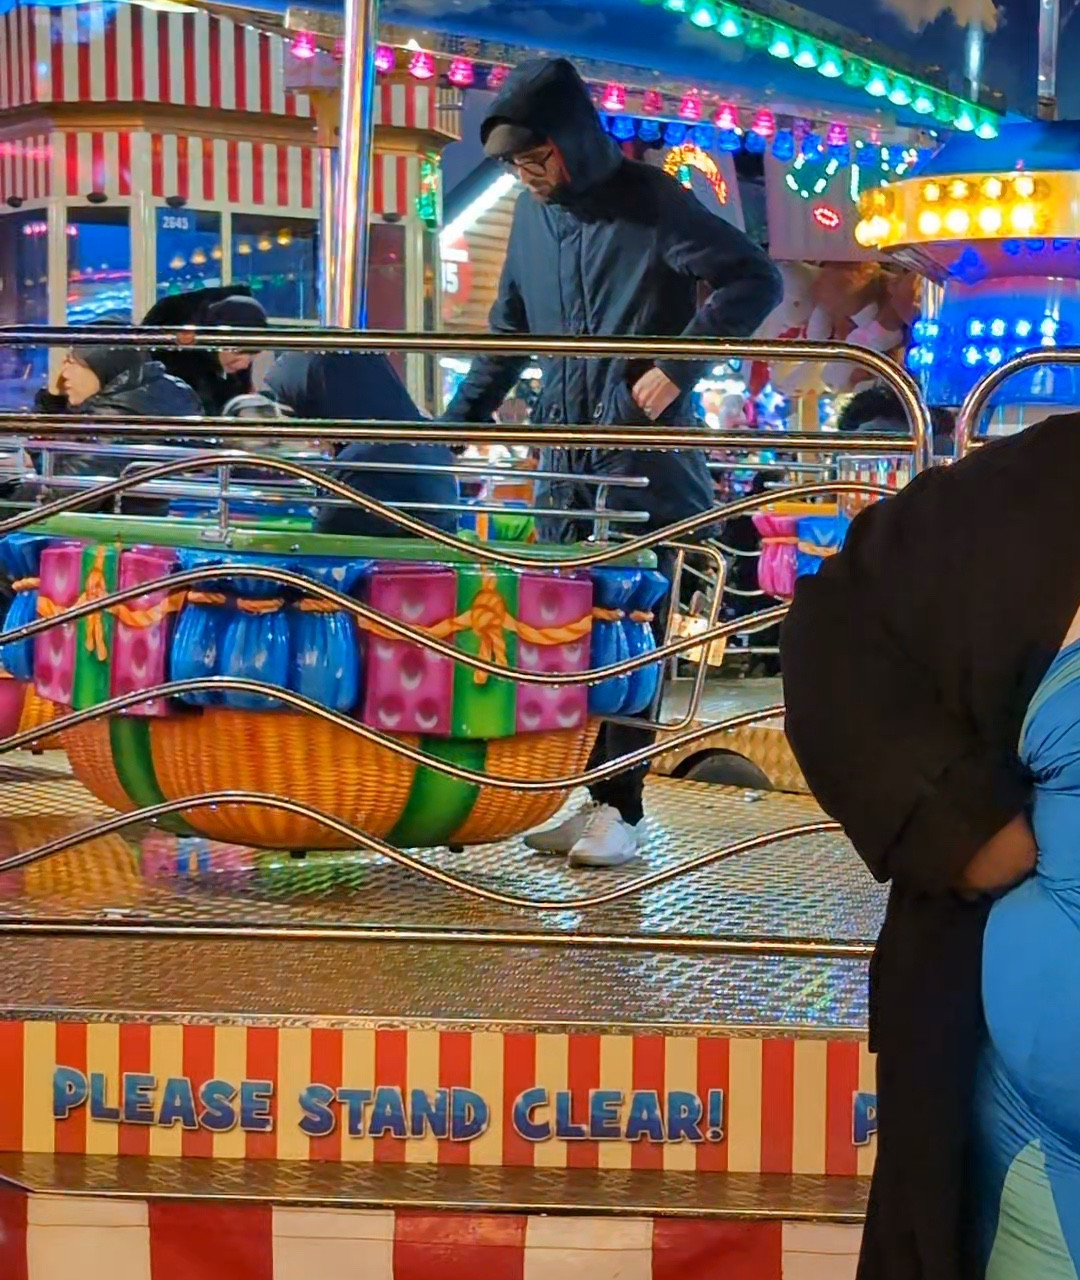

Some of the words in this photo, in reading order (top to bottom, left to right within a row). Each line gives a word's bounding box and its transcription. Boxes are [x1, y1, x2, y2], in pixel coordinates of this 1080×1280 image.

[53, 1065, 273, 1132] PLEASE
[299, 1083, 489, 1142] STAND
[512, 1086, 725, 1141] CLEAR!
